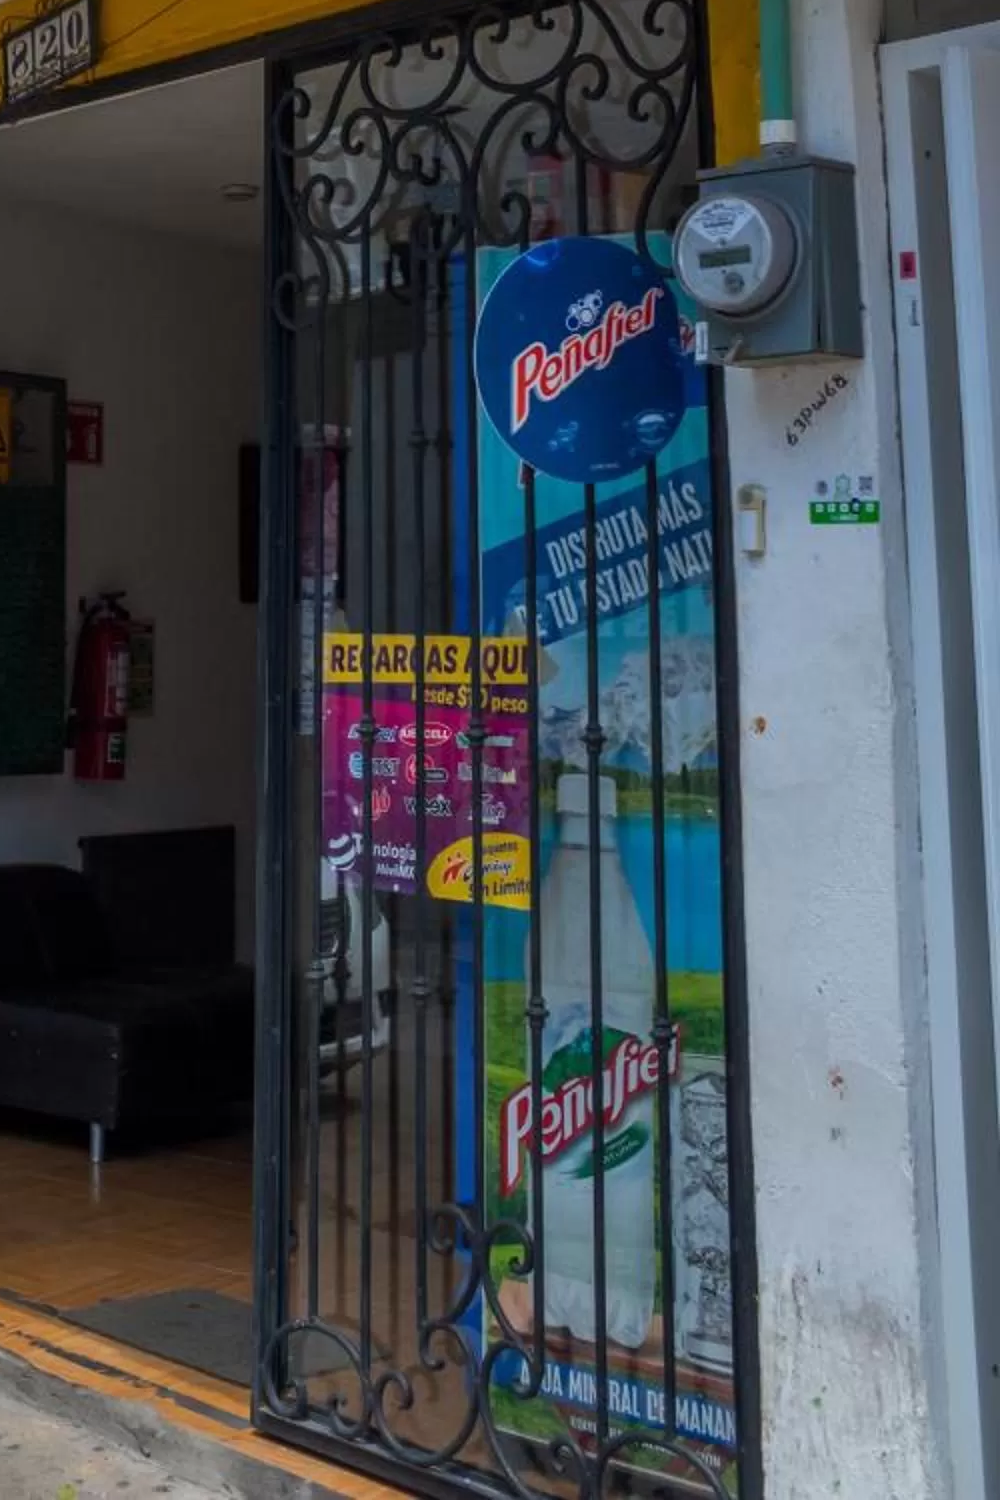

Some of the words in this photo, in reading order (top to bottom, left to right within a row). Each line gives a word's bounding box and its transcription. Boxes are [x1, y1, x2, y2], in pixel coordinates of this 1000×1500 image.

[11, 10, 84, 80] 820
[511, 288, 658, 436] Peñafiel
[656, 479, 704, 536] MÁS
[545, 585, 579, 630] TU
[331, 643, 458, 674] REARAS
[568, 1367, 642, 1418] MINRAL
[675, 1396, 736, 1444] MANAN
